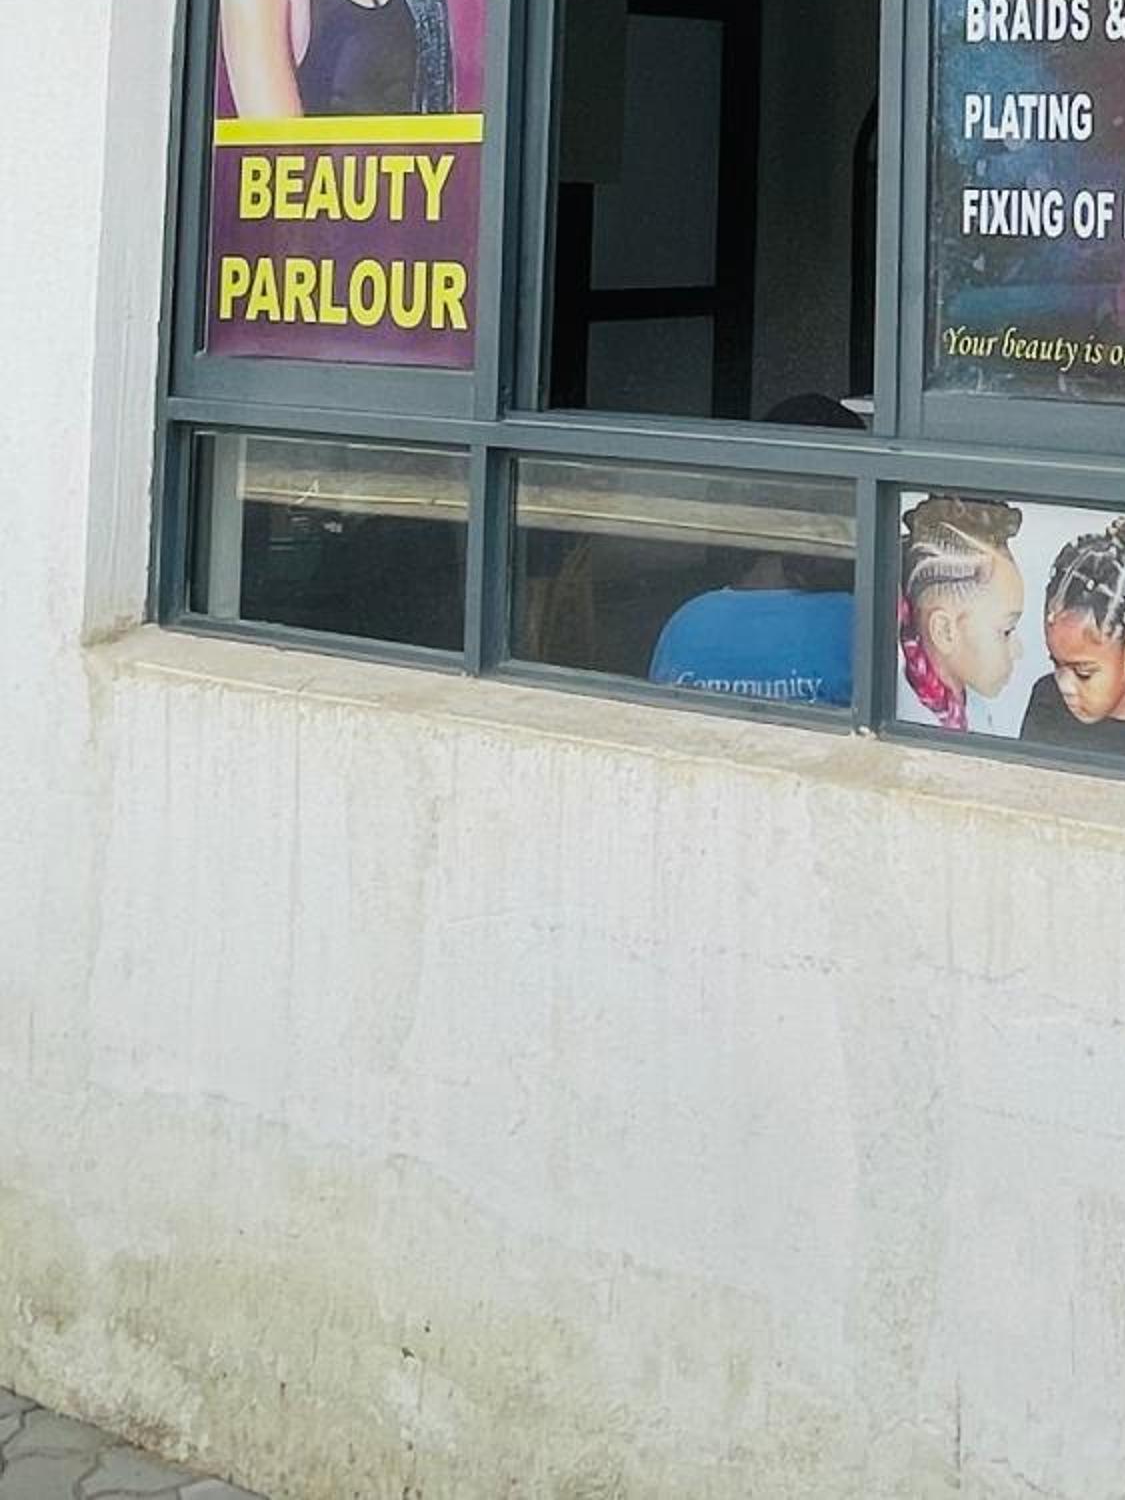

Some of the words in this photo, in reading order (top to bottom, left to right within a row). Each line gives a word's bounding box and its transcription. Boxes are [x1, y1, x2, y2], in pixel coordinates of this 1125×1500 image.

[964, 93, 1093, 141] PLATING
[239, 155, 455, 221] BEAUTY
[962, 190, 1064, 237] FIXING
[1073, 191, 1114, 238] OF
[219, 257, 467, 330] PARLOUR
[943, 326, 997, 357] Your
[1001, 328, 1079, 371] beauty
[1084, 334, 1103, 364] is
